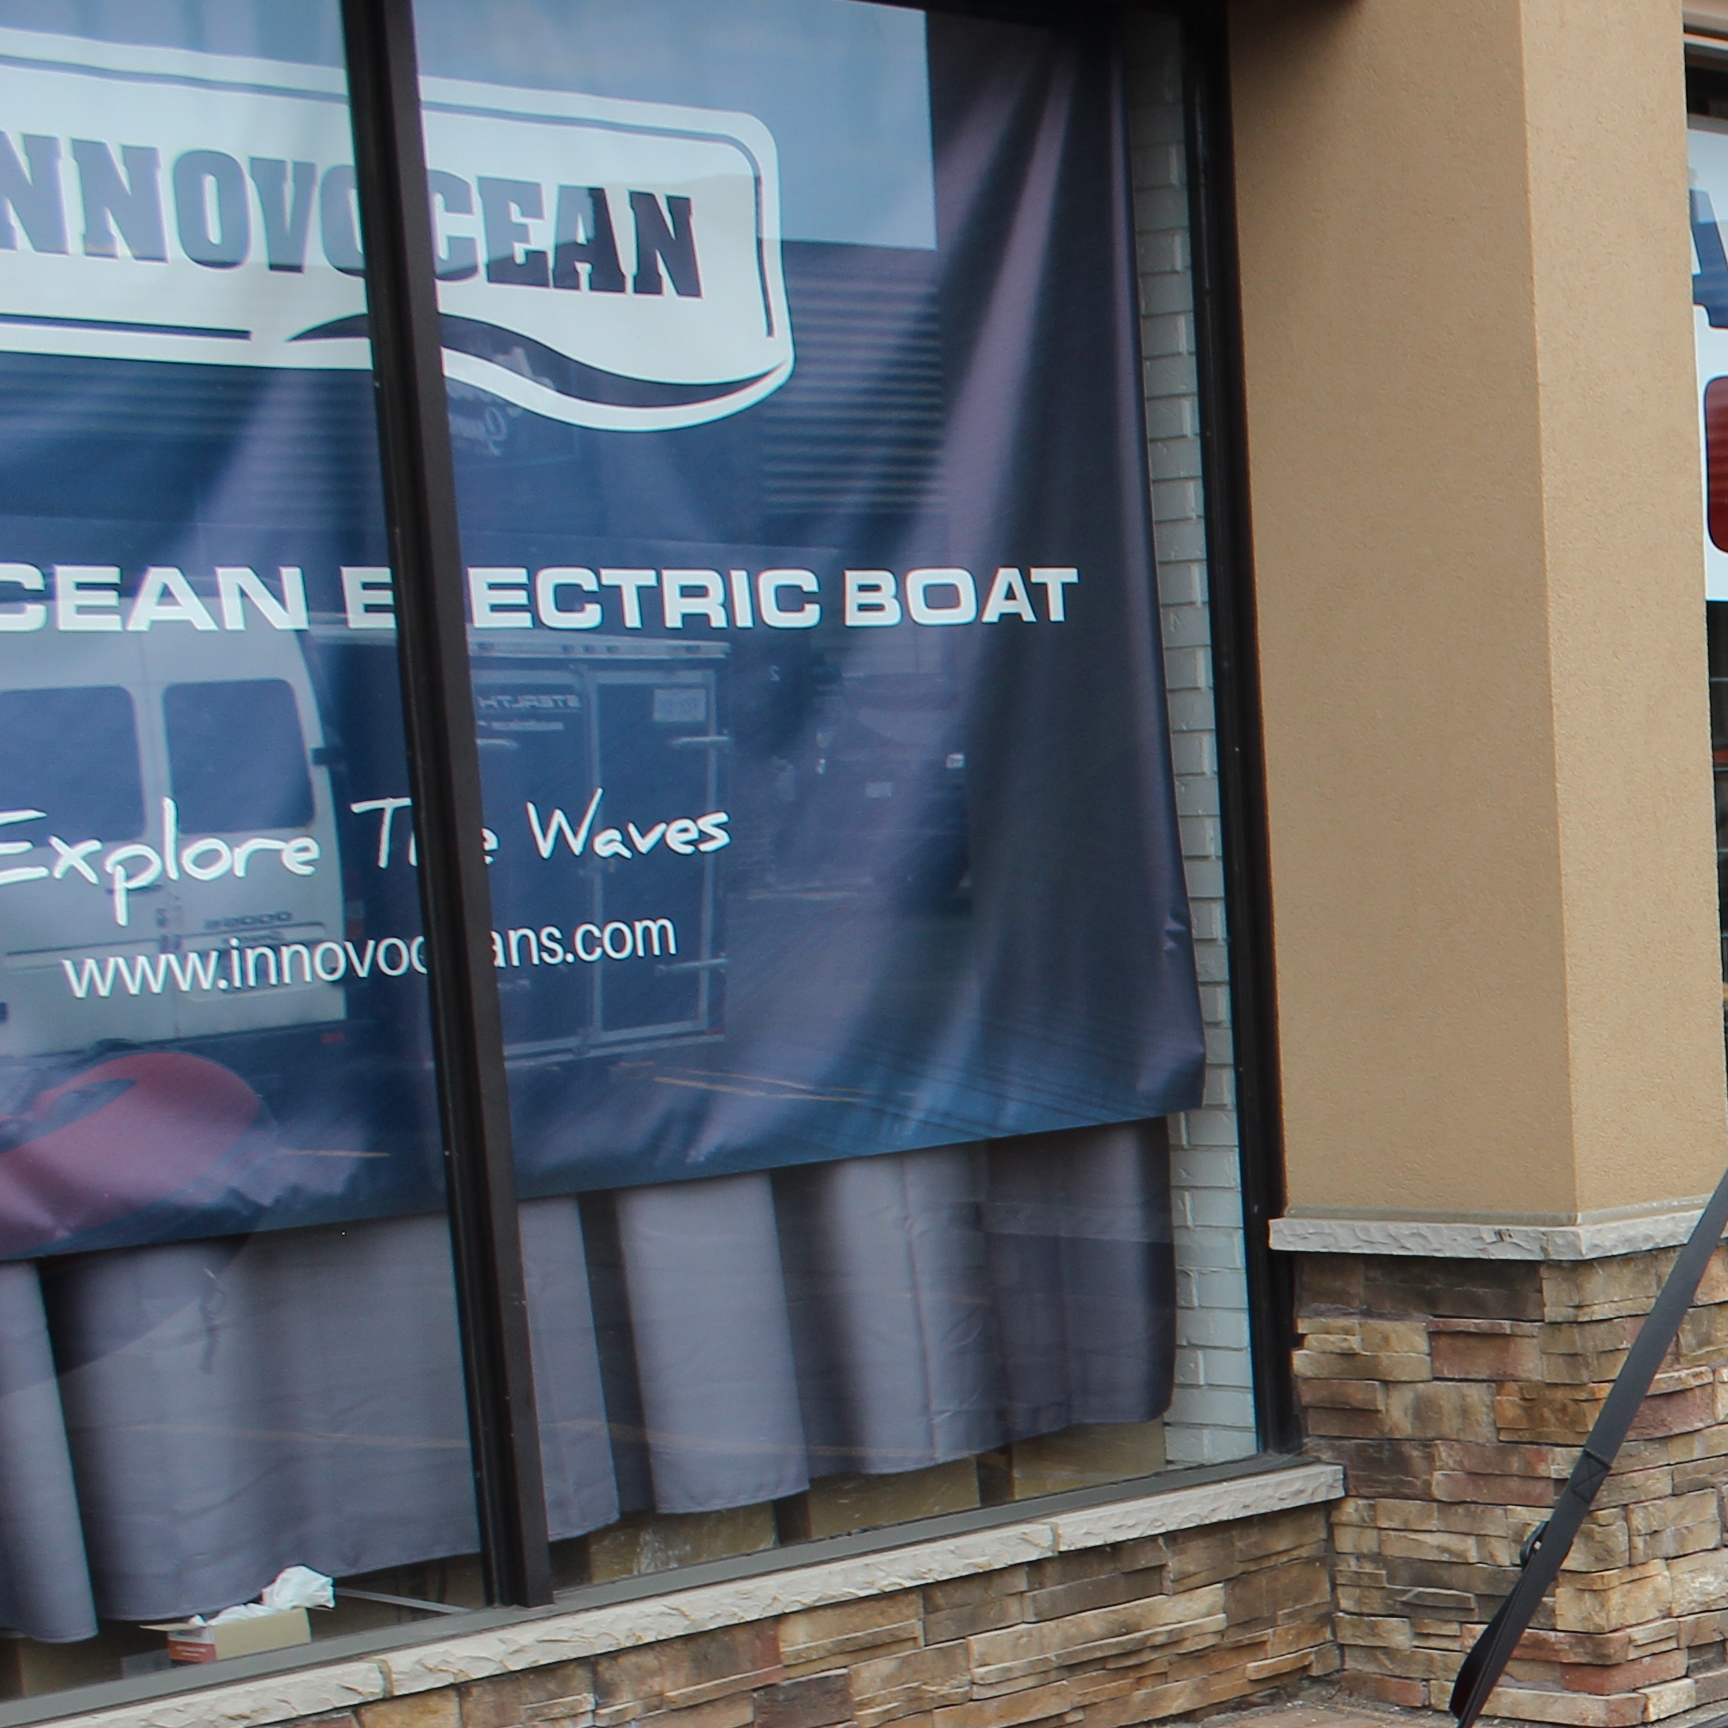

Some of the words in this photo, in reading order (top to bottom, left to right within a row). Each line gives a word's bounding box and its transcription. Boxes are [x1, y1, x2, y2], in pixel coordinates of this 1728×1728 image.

[340, 565, 820, 630] EECTRIC
[845, 567, 1078, 628] BOAT
[0, 796, 321, 927] Explore
[526, 786, 730, 862] Waves
